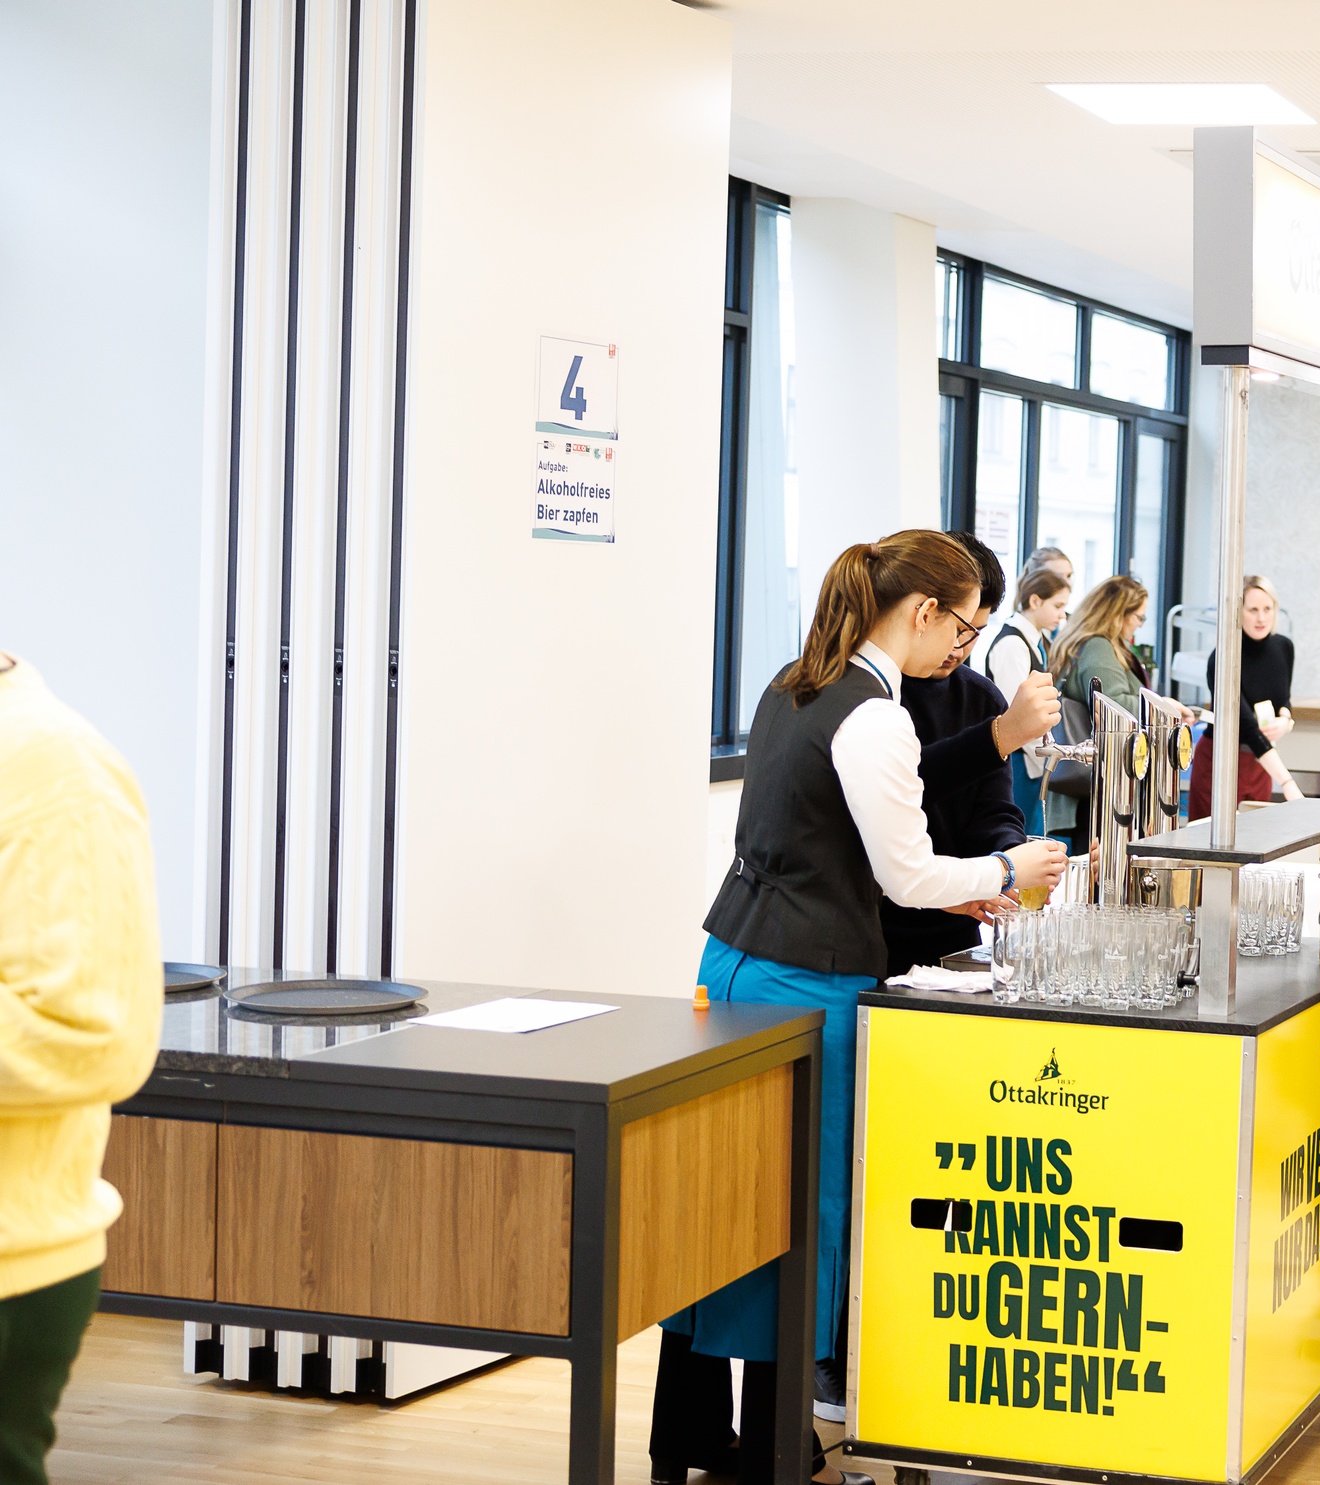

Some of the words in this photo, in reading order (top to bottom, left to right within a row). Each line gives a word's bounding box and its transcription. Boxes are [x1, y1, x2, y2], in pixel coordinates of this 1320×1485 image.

[560, 355, 587, 421] 4
[537, 479, 611, 500] Alkoholfreies
[538, 460, 569, 474] Aufgabe:
[537, 504, 561, 521] Bier
[563, 507, 599, 526] zapfen
[989, 1079, 1110, 1114] Ottakringer
[1280, 1144, 1305, 1223] WIR
[1272, 1216, 1303, 1315] NUR
[933, 1271, 980, 1321] DU
[985, 1260, 1169, 1353] GERN-
